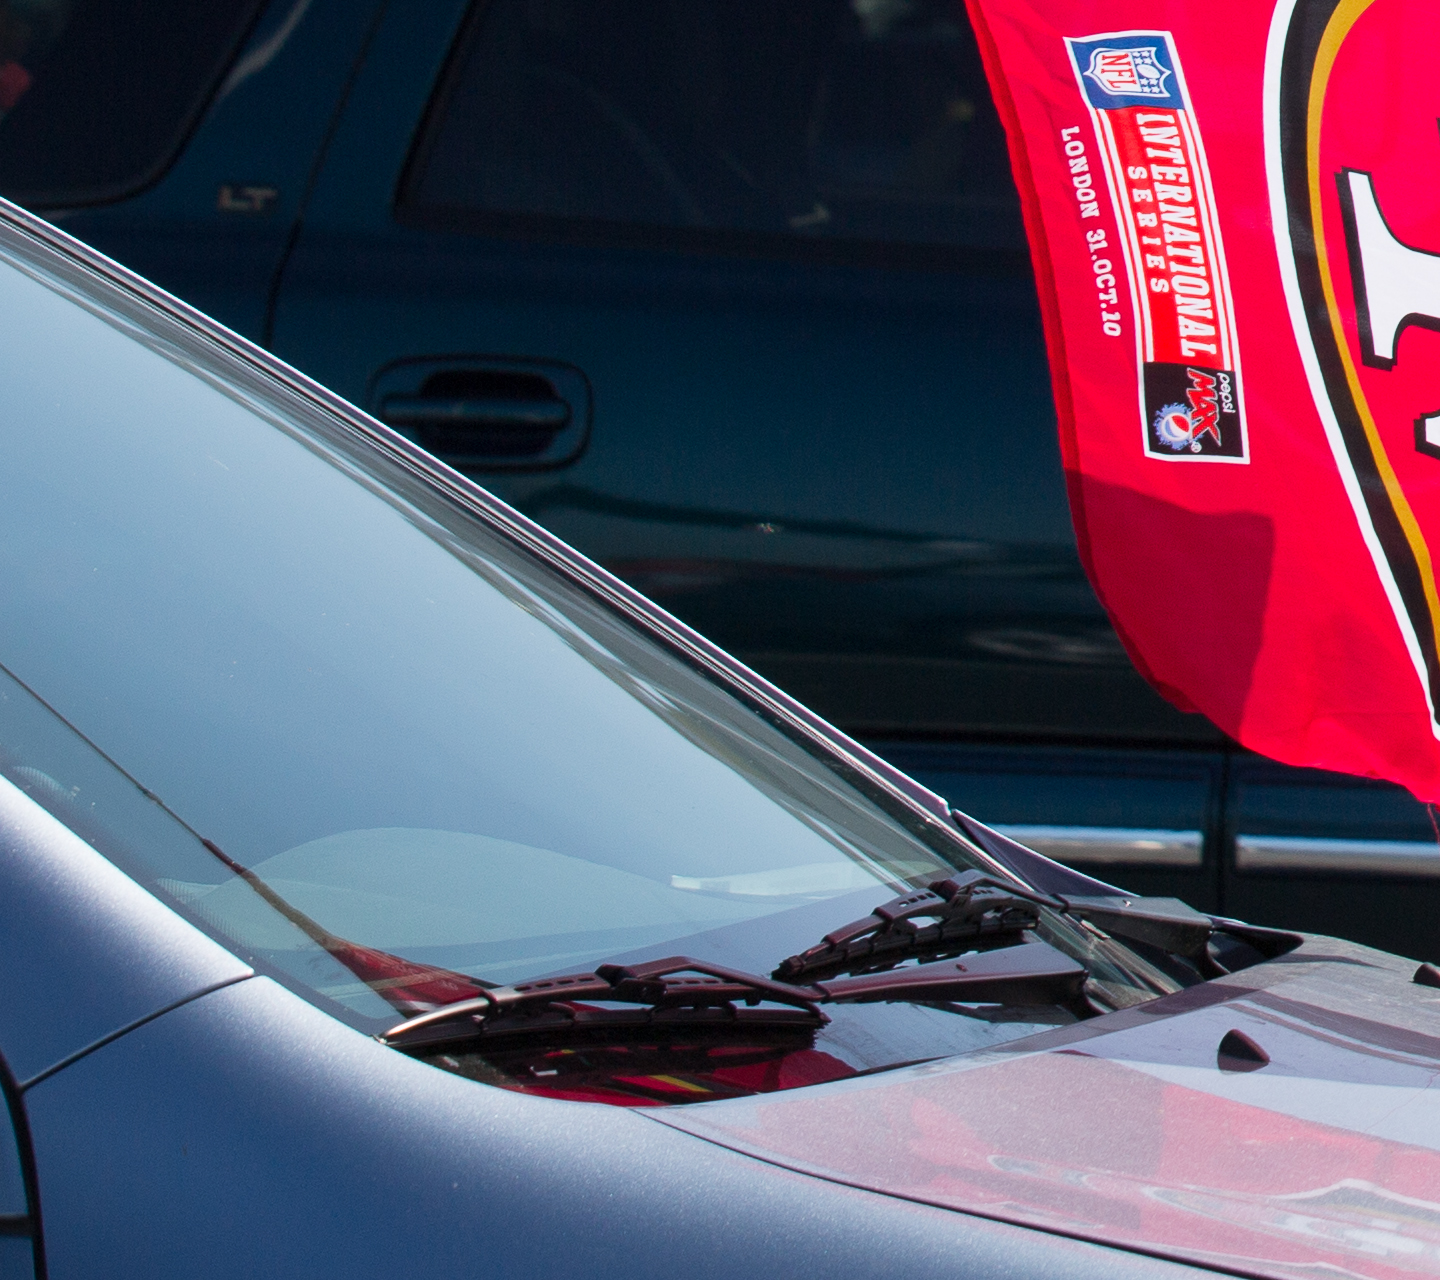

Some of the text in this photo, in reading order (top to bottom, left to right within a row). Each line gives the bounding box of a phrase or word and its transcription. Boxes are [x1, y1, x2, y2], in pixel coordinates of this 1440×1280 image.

[1100, 52, 1138, 89] NFL
[218, 185, 278, 211] LT
[1060, 125, 1122, 337] LONDON 31.OCT.10
[1127, 165, 1170, 293] SERIES
[1135, 112, 1217, 358] INTERNATIONAL
[1186, 366, 1222, 447] MAX
[1216, 372, 1237, 414] pepsi
